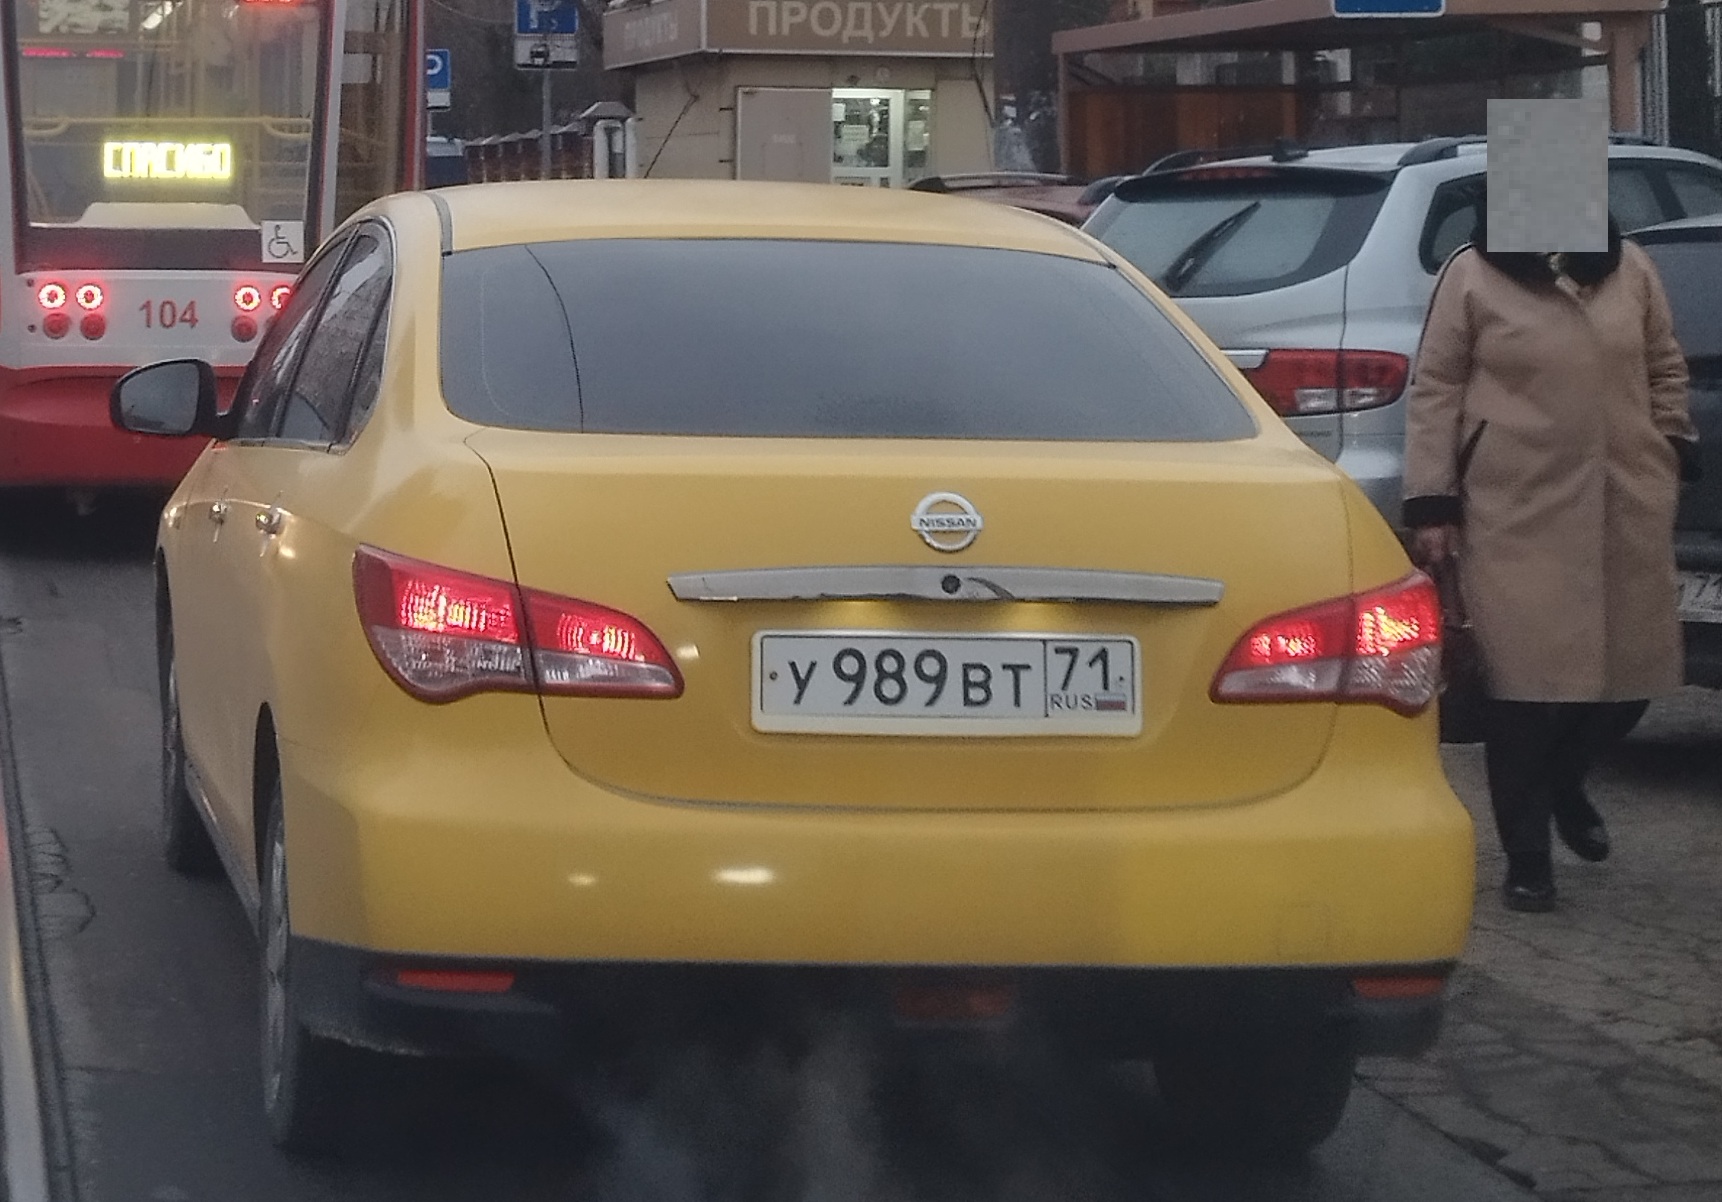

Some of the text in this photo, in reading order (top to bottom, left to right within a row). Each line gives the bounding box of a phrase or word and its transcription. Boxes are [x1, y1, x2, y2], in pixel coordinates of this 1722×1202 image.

[104, 142, 231, 178] СПАСИБО
[139, 300, 199, 328] 104
[919, 517, 977, 529] NISSAN
[1054, 646, 1111, 692] 71
[1050, 693, 1094, 711] RUS
